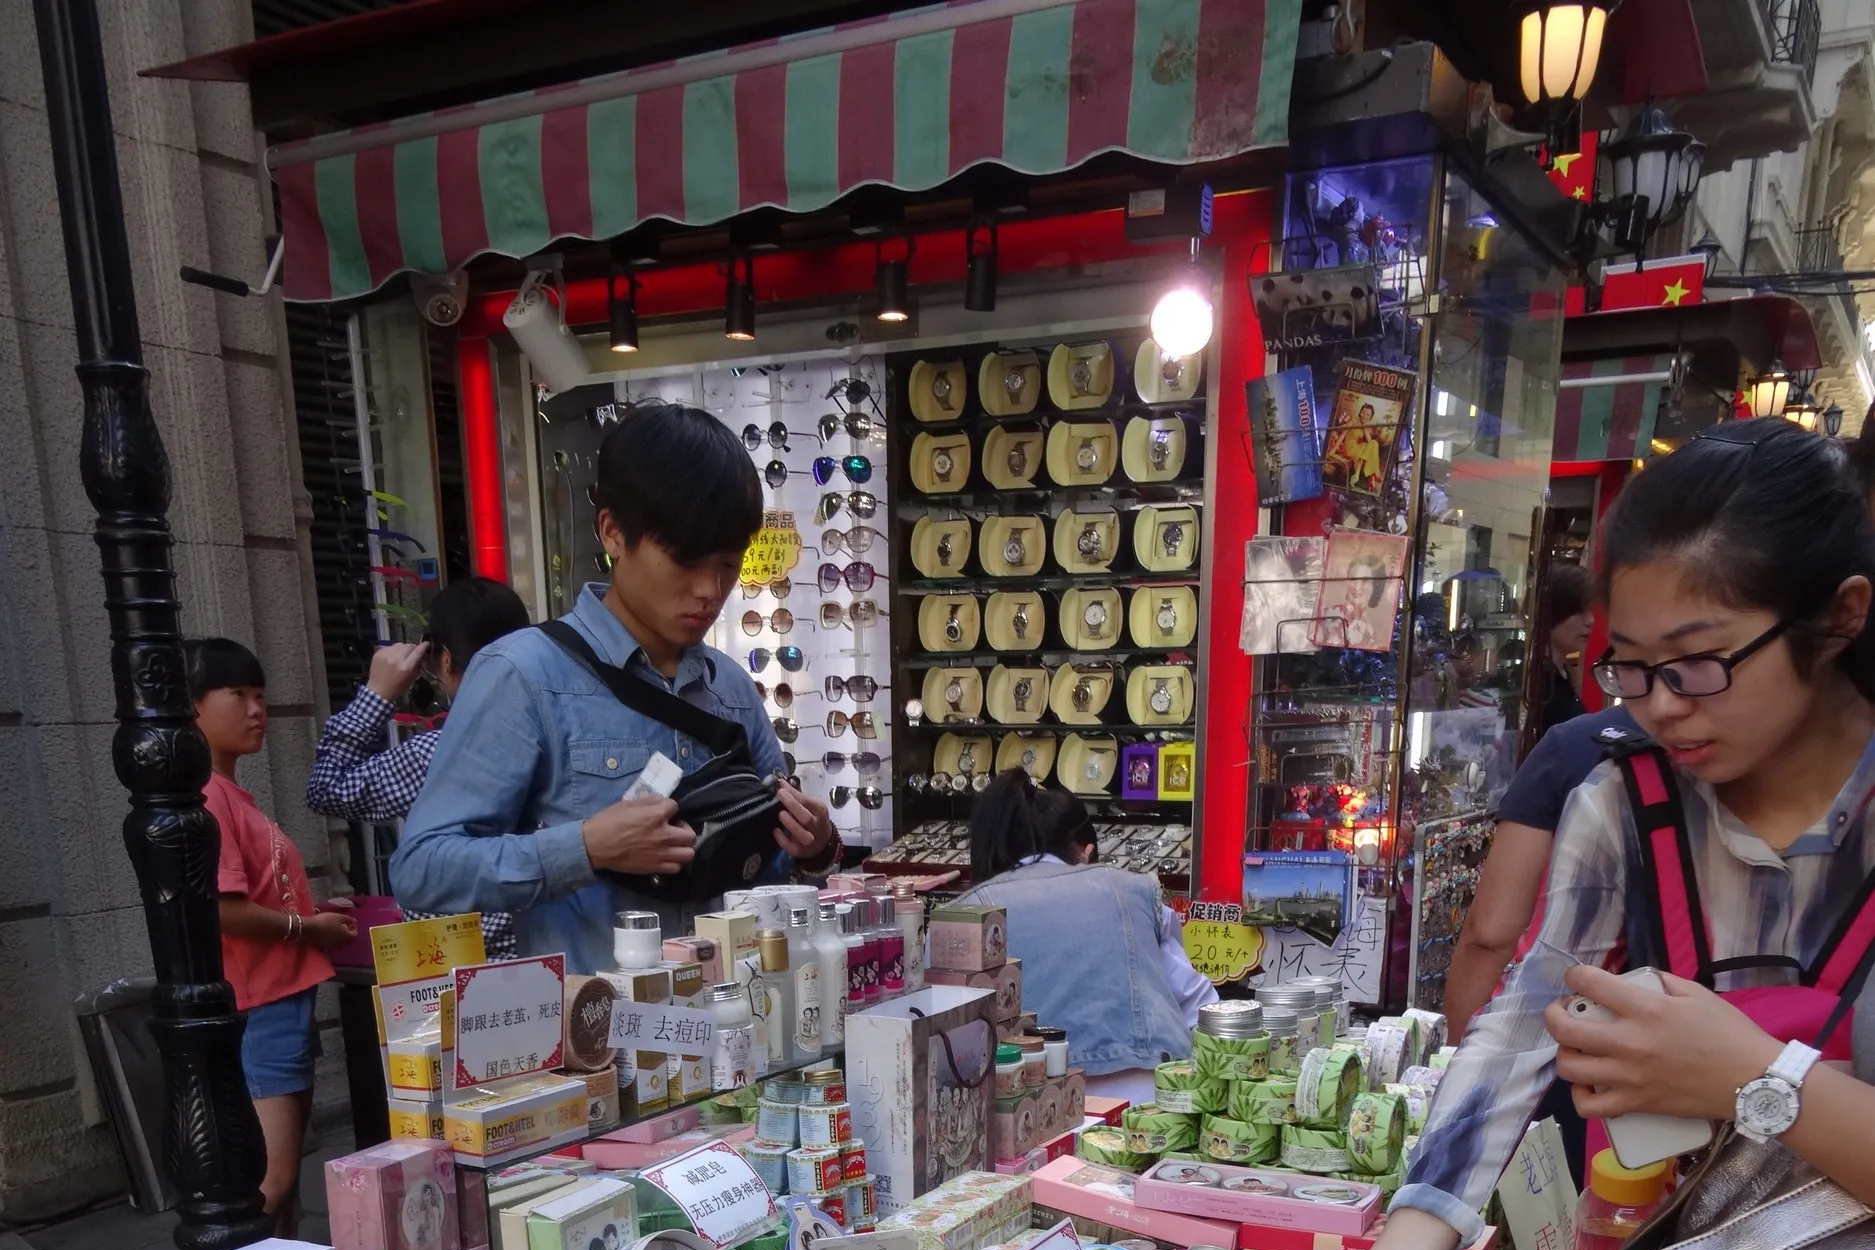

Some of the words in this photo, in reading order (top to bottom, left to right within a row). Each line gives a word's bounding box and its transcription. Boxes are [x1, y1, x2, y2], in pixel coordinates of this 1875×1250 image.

[1264, 333, 1323, 352] PANDAS
[1190, 943, 1218, 961] 20
[675, 968, 701, 981] QUEEN
[612, 1010, 643, 1037] 淡斑
[652, 1014, 712, 1045] 去痘印
[485, 1052, 540, 1079] 国色天香
[485, 1115, 536, 1141] FOOT&HEEL
[681, 1160, 728, 1187] 减肥皂
[688, 1177, 765, 1222] 无压力瘦身神器
